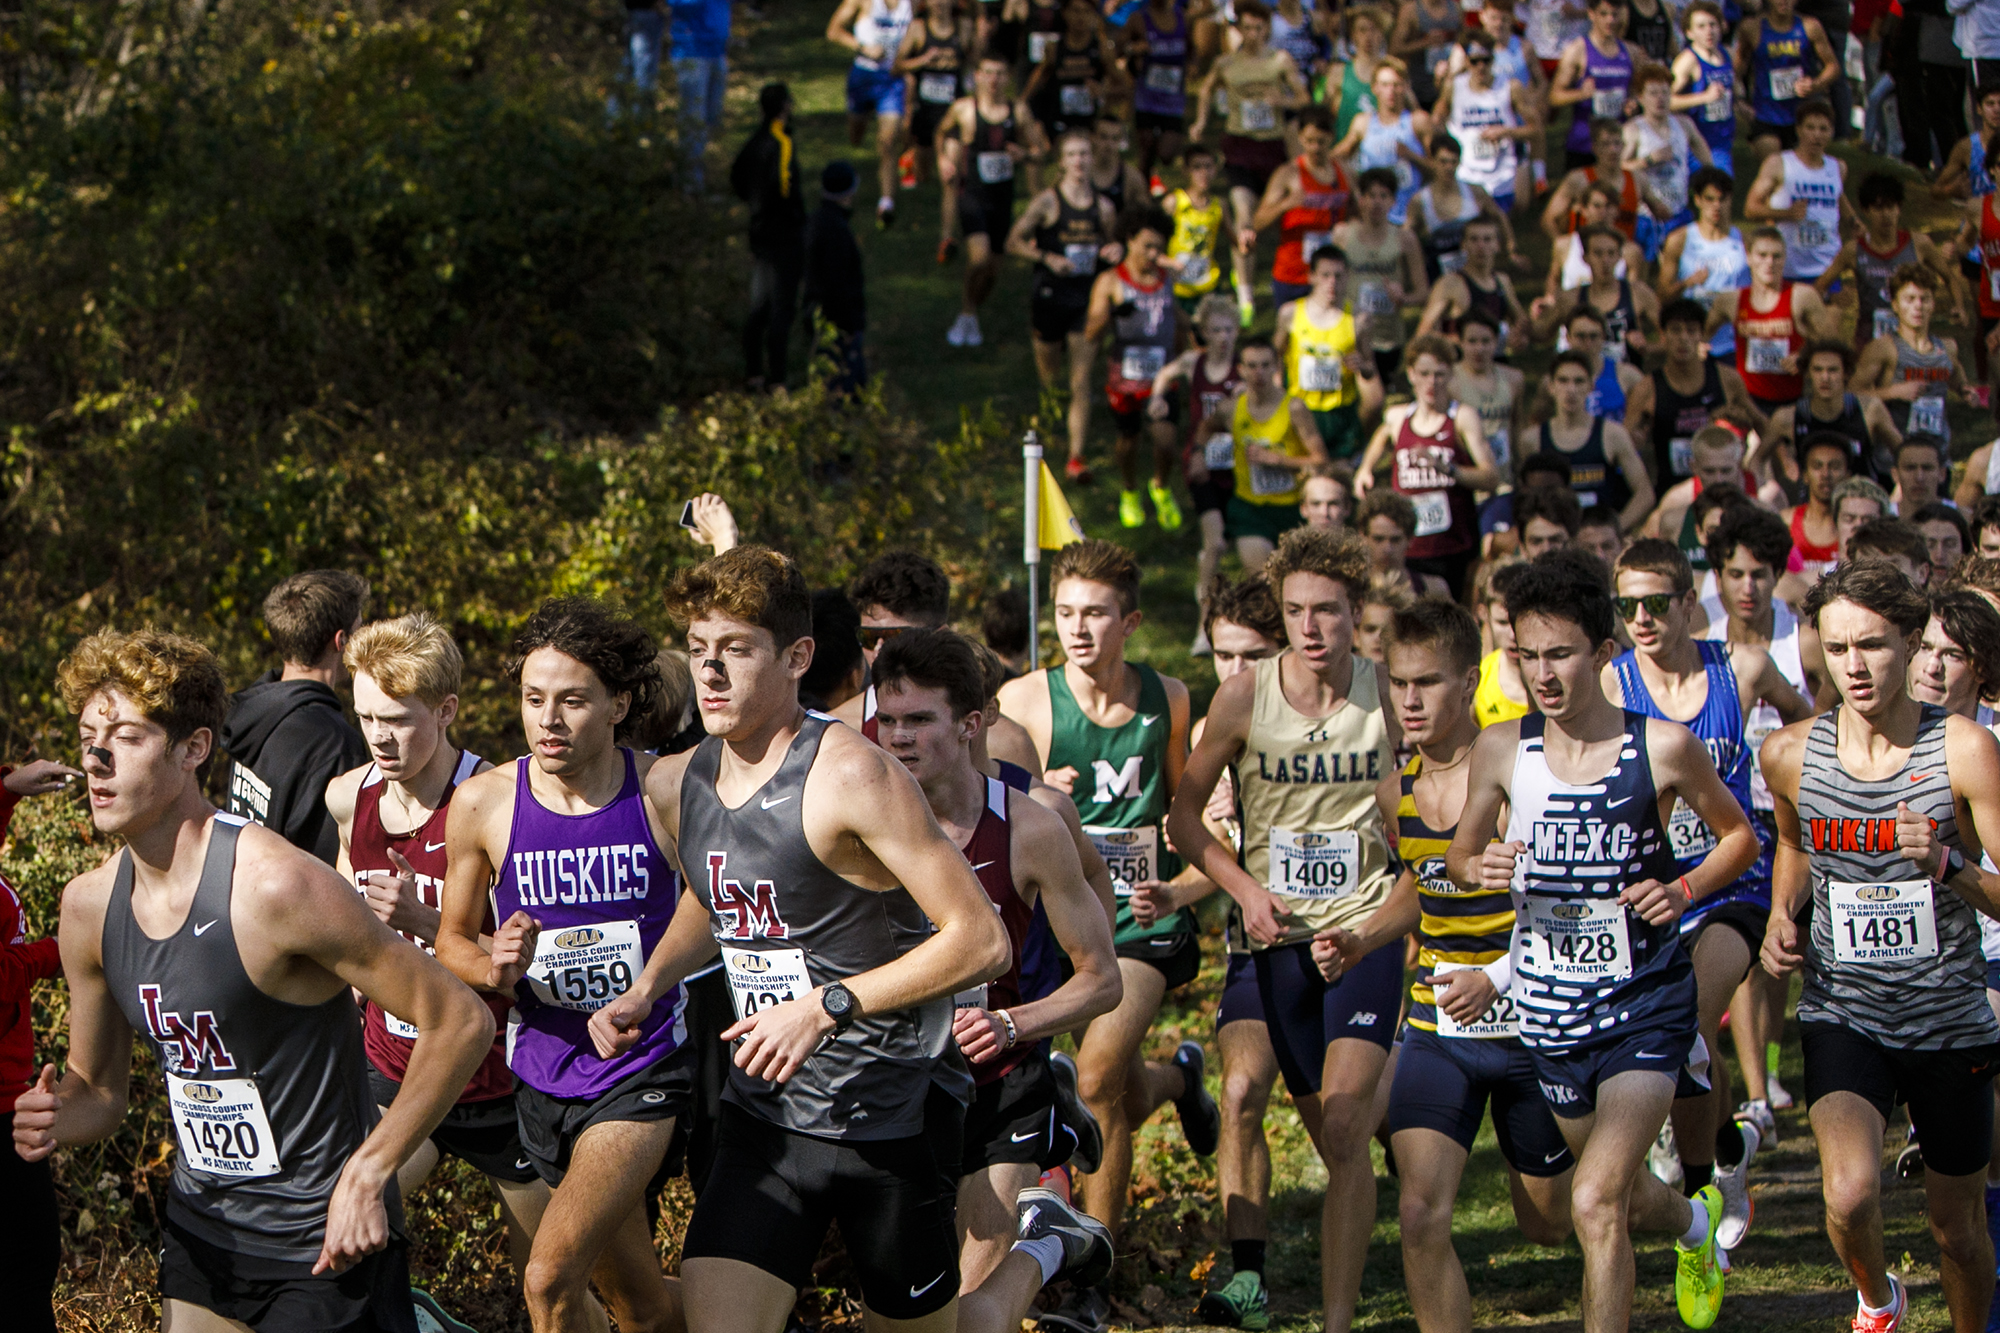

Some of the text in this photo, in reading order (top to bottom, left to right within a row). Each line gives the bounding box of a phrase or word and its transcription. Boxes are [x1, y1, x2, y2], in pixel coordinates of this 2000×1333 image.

[1091, 755, 1144, 803] M
[1533, 822, 1632, 862] MTXC
[1810, 818, 1939, 852] VIKIN
[513, 843, 650, 906] HUSKIES
[1280, 858, 1347, 887] 1409
[706, 850, 789, 941] LM
[1299, 886, 1338, 896] ATHLETIC
[1861, 886, 1898, 900] PIAA
[1836, 903, 1856, 911] 2025
[1886, 901, 1925, 909] COUNTRY
[1847, 908, 1915, 917] CHAMPIONSHIPS
[1535, 917, 1618, 927] 2025 CROSS COUNTRY
[1545, 925, 1608, 934] CHAMPIONSHIPS
[562, 930, 602, 947] PIAA
[1843, 916, 1919, 948] 1481
[557, 950, 588, 960] CROSS
[590, 942, 632, 957] COUNTRY
[1542, 932, 1618, 963] 1428
[1869, 947, 1915, 957] ATHLETIC
[545, 952, 621, 969] CHAMPIONSHIPS
[1566, 964, 1608, 973] ATHLETIC
[542, 961, 633, 1002] 1559
[735, 973, 759, 983] CROSS
[760, 974, 800, 983] COUNTRY
[138, 983, 237, 1074] LM
[1469, 1024, 1509, 1034] ATHLETIC
[185, 1084, 220, 1101] PIAA
[173, 1099, 254, 1114] 2025 CROSS COUNTRY
[183, 1110, 244, 1121] CHAMPIONSHIPS
[184, 1118, 260, 1159] 1420
[214, 1158, 254, 1171] ATHLETIC
